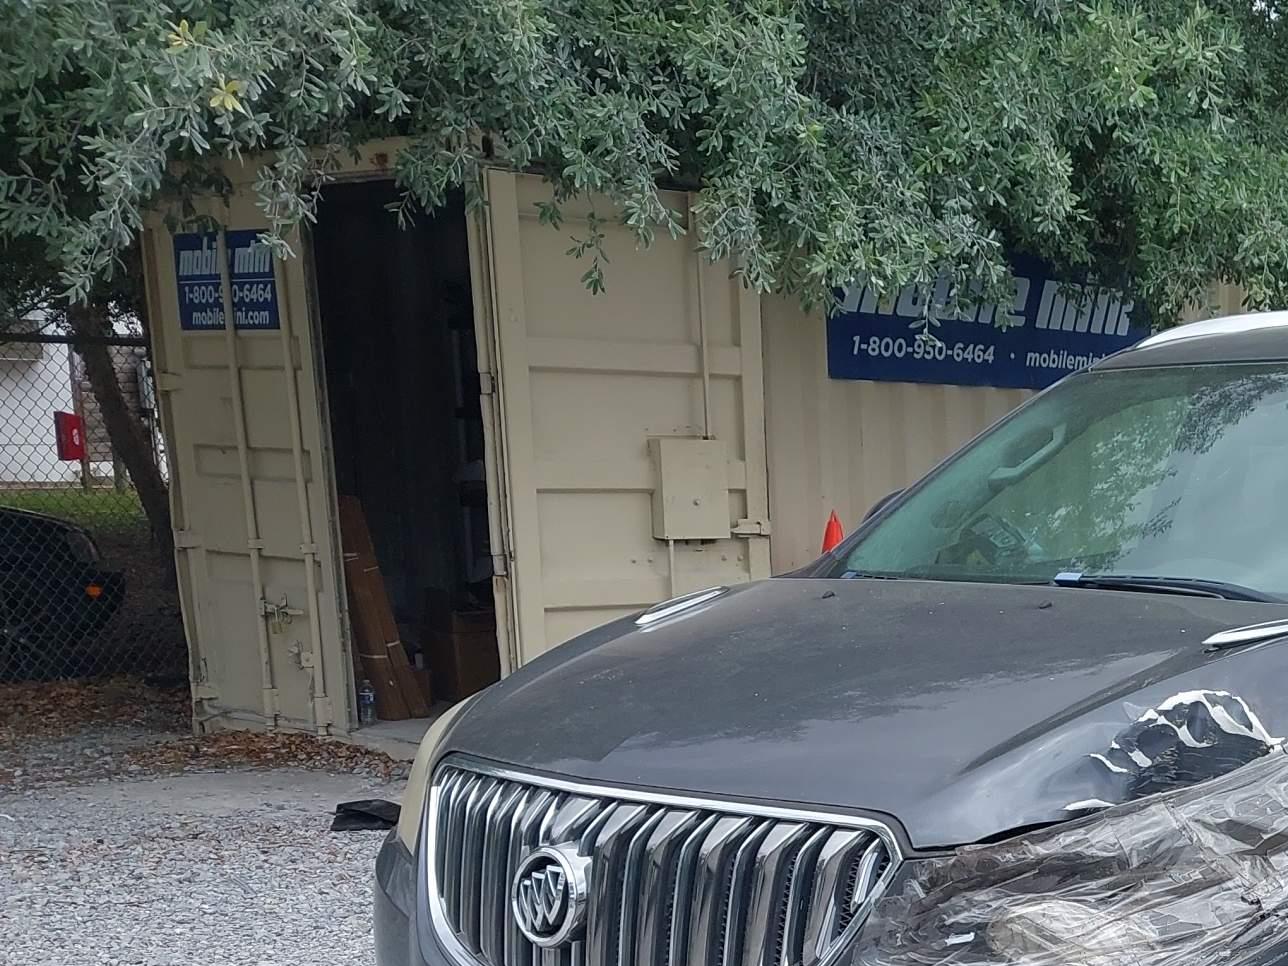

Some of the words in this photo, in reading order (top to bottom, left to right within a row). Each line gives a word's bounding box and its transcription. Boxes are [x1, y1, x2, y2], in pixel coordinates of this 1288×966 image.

[179, 236, 231, 275] mobi
[184, 284, 272, 304] 1-800-90-6464
[192, 307, 270, 325] mobileini.com
[852, 335, 995, 364] 1-800-950-6464
[1026, 349, 1105, 370] mobilemi
